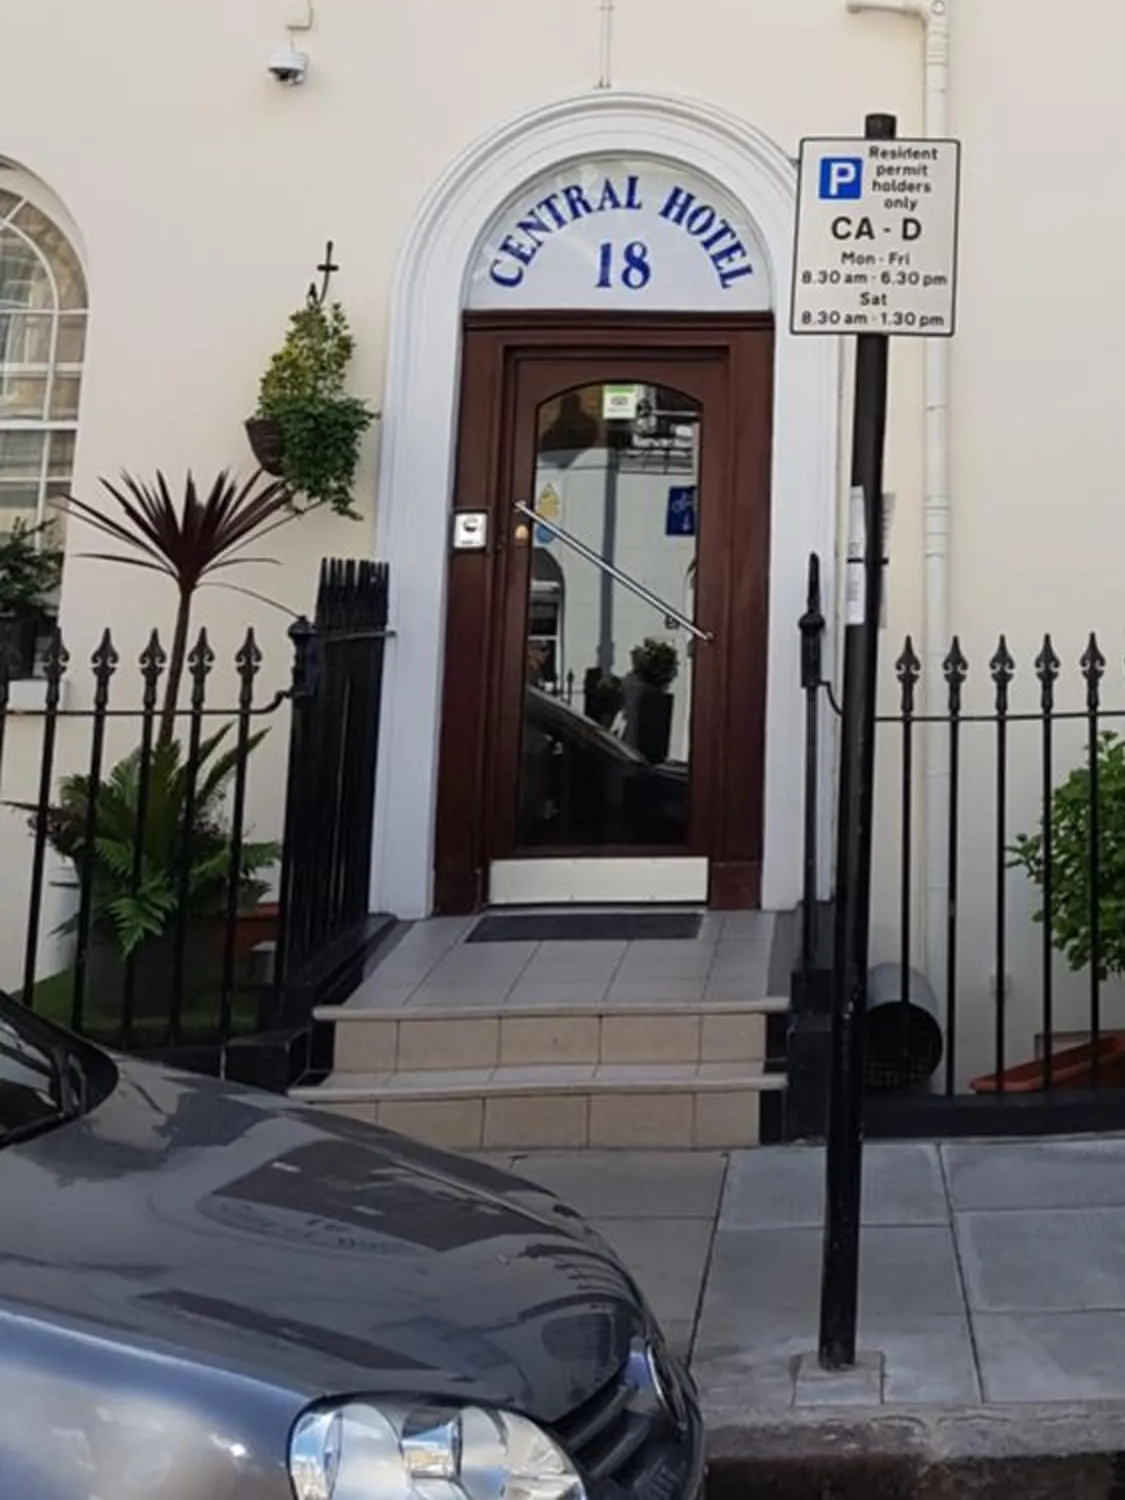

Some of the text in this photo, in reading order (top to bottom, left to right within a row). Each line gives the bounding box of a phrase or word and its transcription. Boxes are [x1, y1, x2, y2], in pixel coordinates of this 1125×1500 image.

[869, 146, 938, 161] Resident
[875, 163, 928, 177] permit
[830, 162, 856, 196] P
[871, 180, 932, 193] holders
[883, 196, 918, 212] only
[489, 175, 753, 289] CENTRAL HOTEL
[902, 217, 922, 241] D
[595, 241, 651, 289] 18
[841, 252, 876, 265] Mon
[888, 252, 910, 265] Fri
[801, 270, 841, 285] 8.30
[844, 273, 867, 285] am
[880, 271, 919, 285] 6.30
[923, 274, 948, 287] pm
[860, 292, 887, 306] Sat
[801, 311, 841, 325] 8.30
[844, 313, 867, 325] am
[881, 312, 916, 325] 1.30
[919, 315, 944, 328] pm
